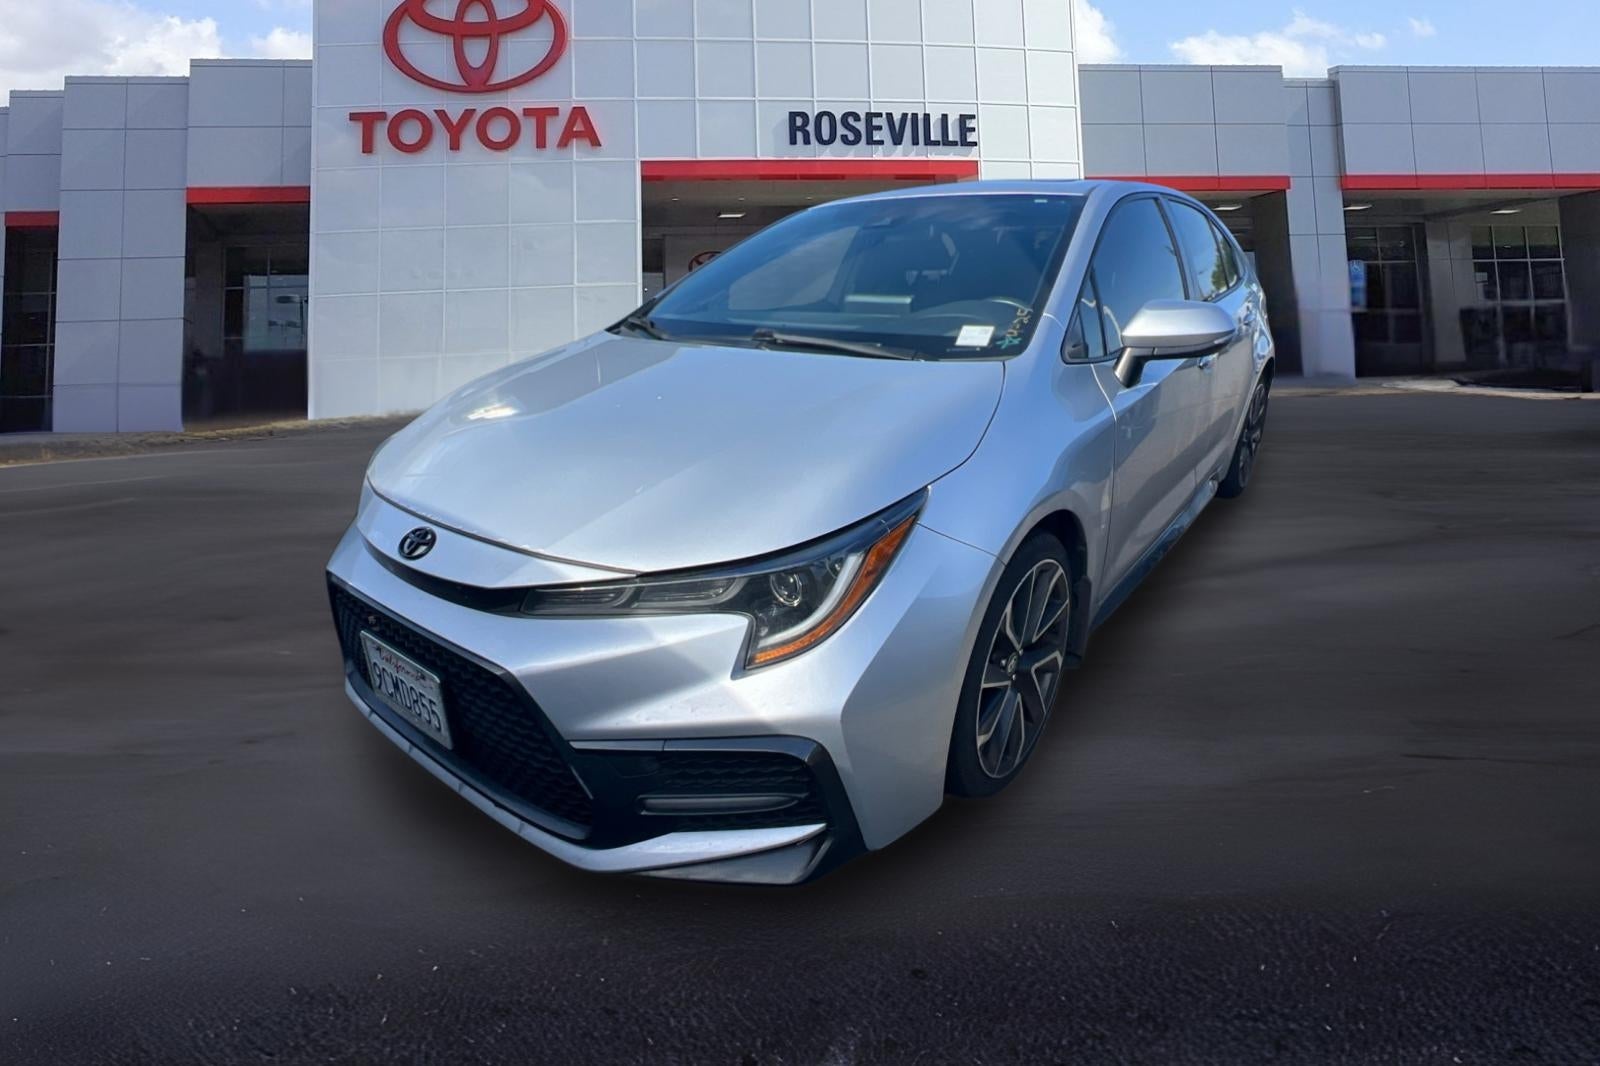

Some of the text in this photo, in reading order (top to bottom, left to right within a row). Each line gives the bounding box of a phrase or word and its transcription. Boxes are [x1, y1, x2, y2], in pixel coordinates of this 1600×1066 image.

[349, 106, 602, 154] TOYOTA
[788, 111, 978, 147] ROSEVILLE
[373, 662, 441, 731] 9CMD855
